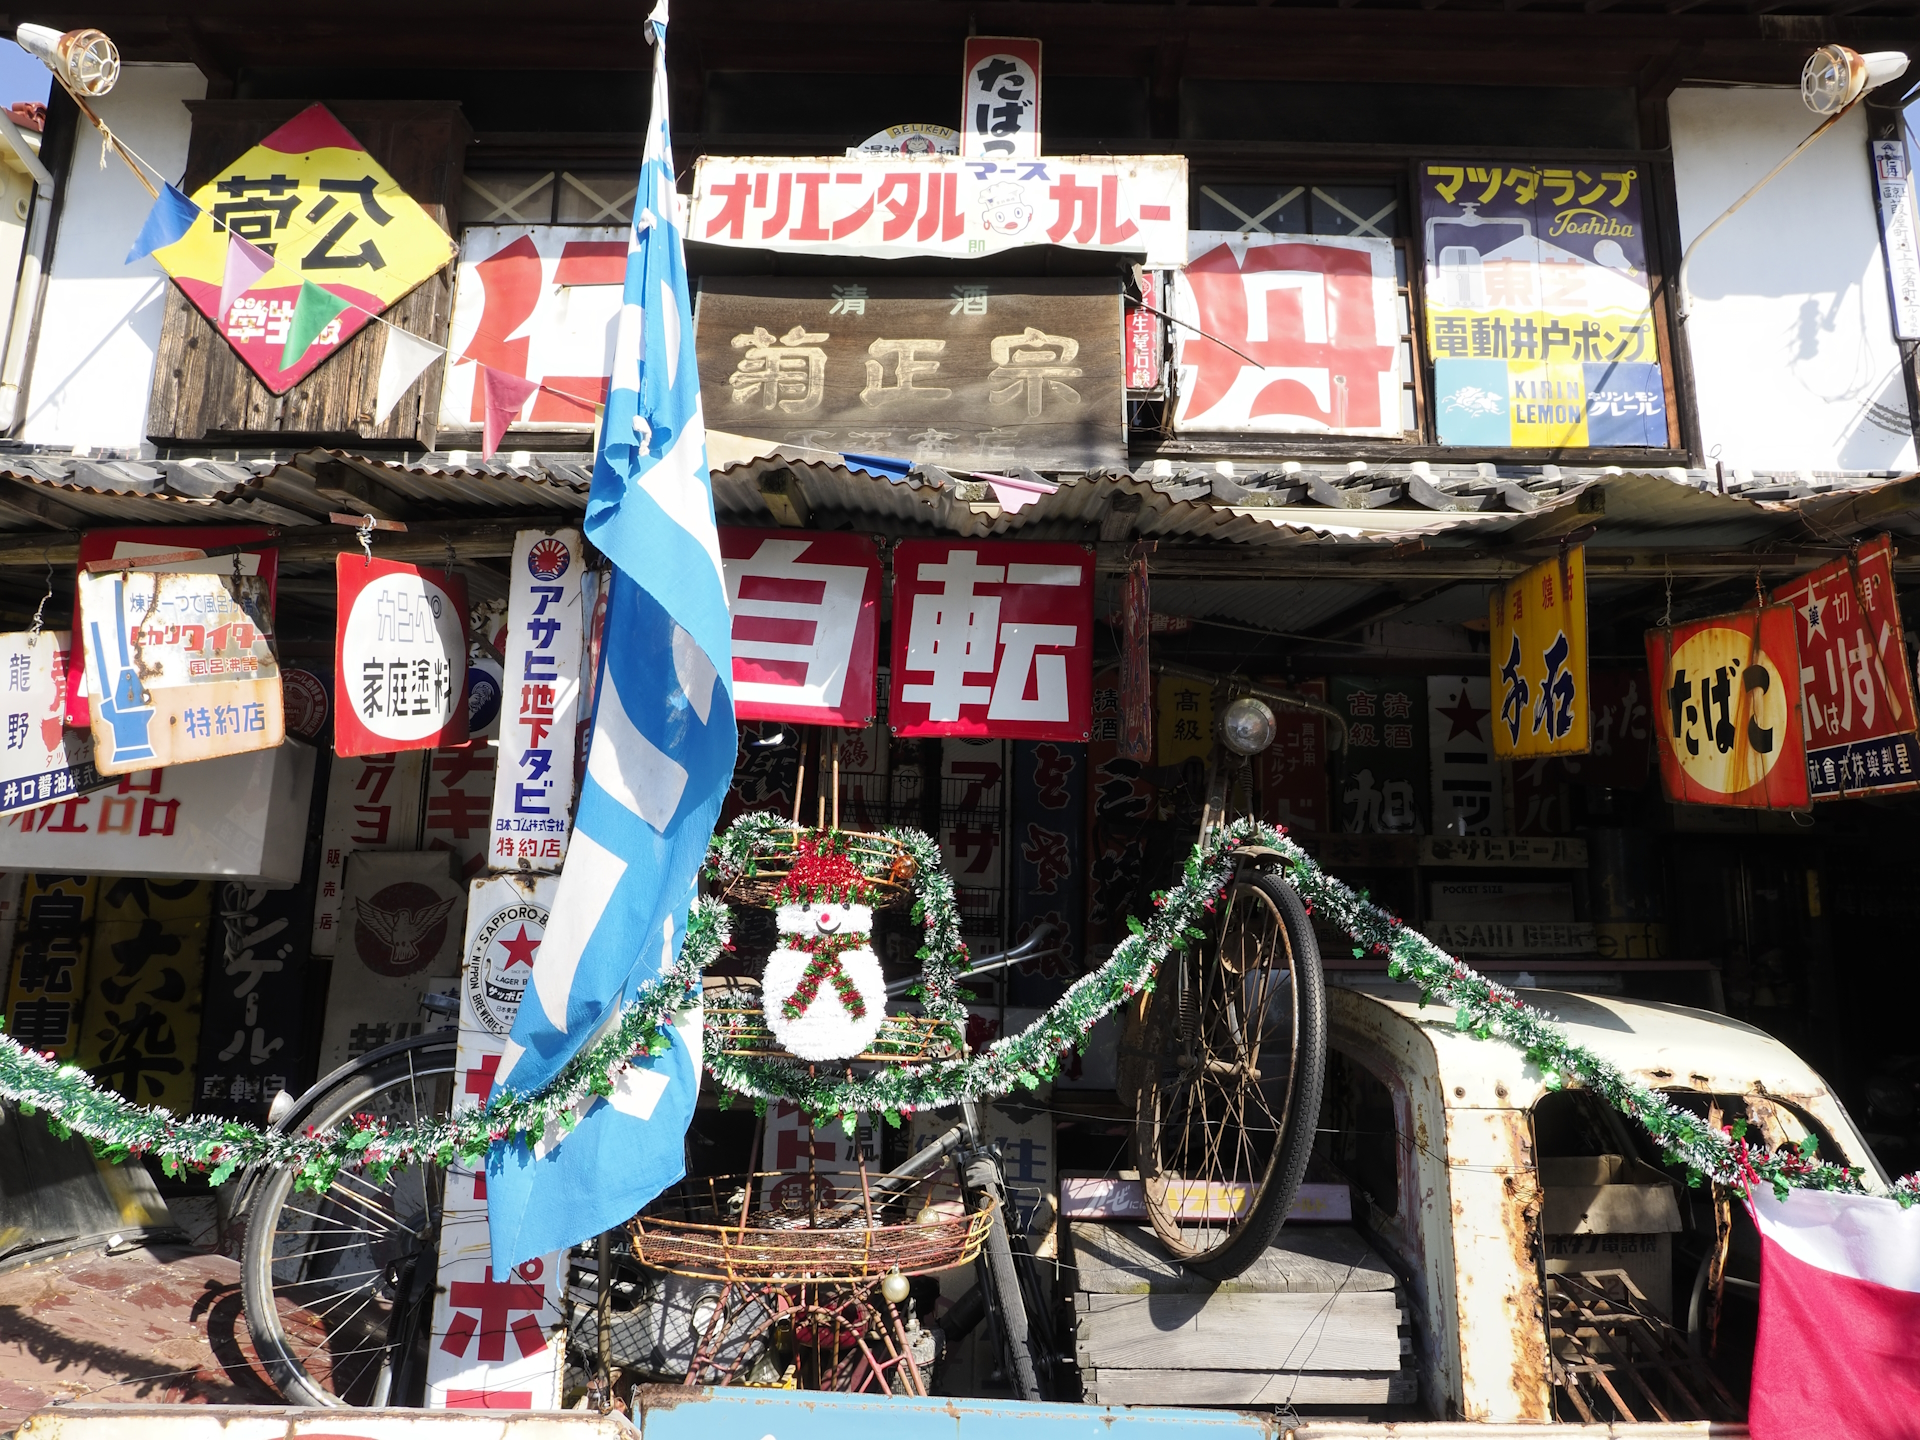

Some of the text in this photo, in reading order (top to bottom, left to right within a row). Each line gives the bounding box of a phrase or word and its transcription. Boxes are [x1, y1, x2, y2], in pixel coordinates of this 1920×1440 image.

[892, 124, 950, 138] BELIKEN
[965, 162, 1052, 181] マース
[1427, 166, 1638, 208] マツダランプ
[706, 171, 965, 243] オリエンタル
[1045, 173, 1172, 244] カレー
[1549, 208, 1635, 238] Toshiba
[829, 283, 988, 316] 清酒
[1482, 256, 1589, 308] 東芝
[729, 325, 1083, 418] 菊正宗
[1514, 380, 1579, 400] KIRIN
[1587, 391, 1659, 402] キリンレモン
[1516, 404, 1581, 425] LEMON
[7, 653, 31, 750] 龍野
[363, 656, 451, 718] 家庭塗料
[513, 586, 562, 814] アサヒ地下タビ
[185, 702, 265, 738] 特約店
[1667, 658, 1773, 756] たばこ
[46, 744, 90, 768] タツノイチ
[496, 818, 565, 832] 日本ゴム株式会社
[496, 837, 561, 857] 特約店
[318, 848, 341, 930] 販売店
[1443, 886, 1504, 895] POCKET SIZE
[479, 906, 538, 945] SAPPORO
[469, 955, 481, 990] NIPPON
[495, 974, 519, 985] LAGER
[472, 993, 504, 1035] BREWERIES
